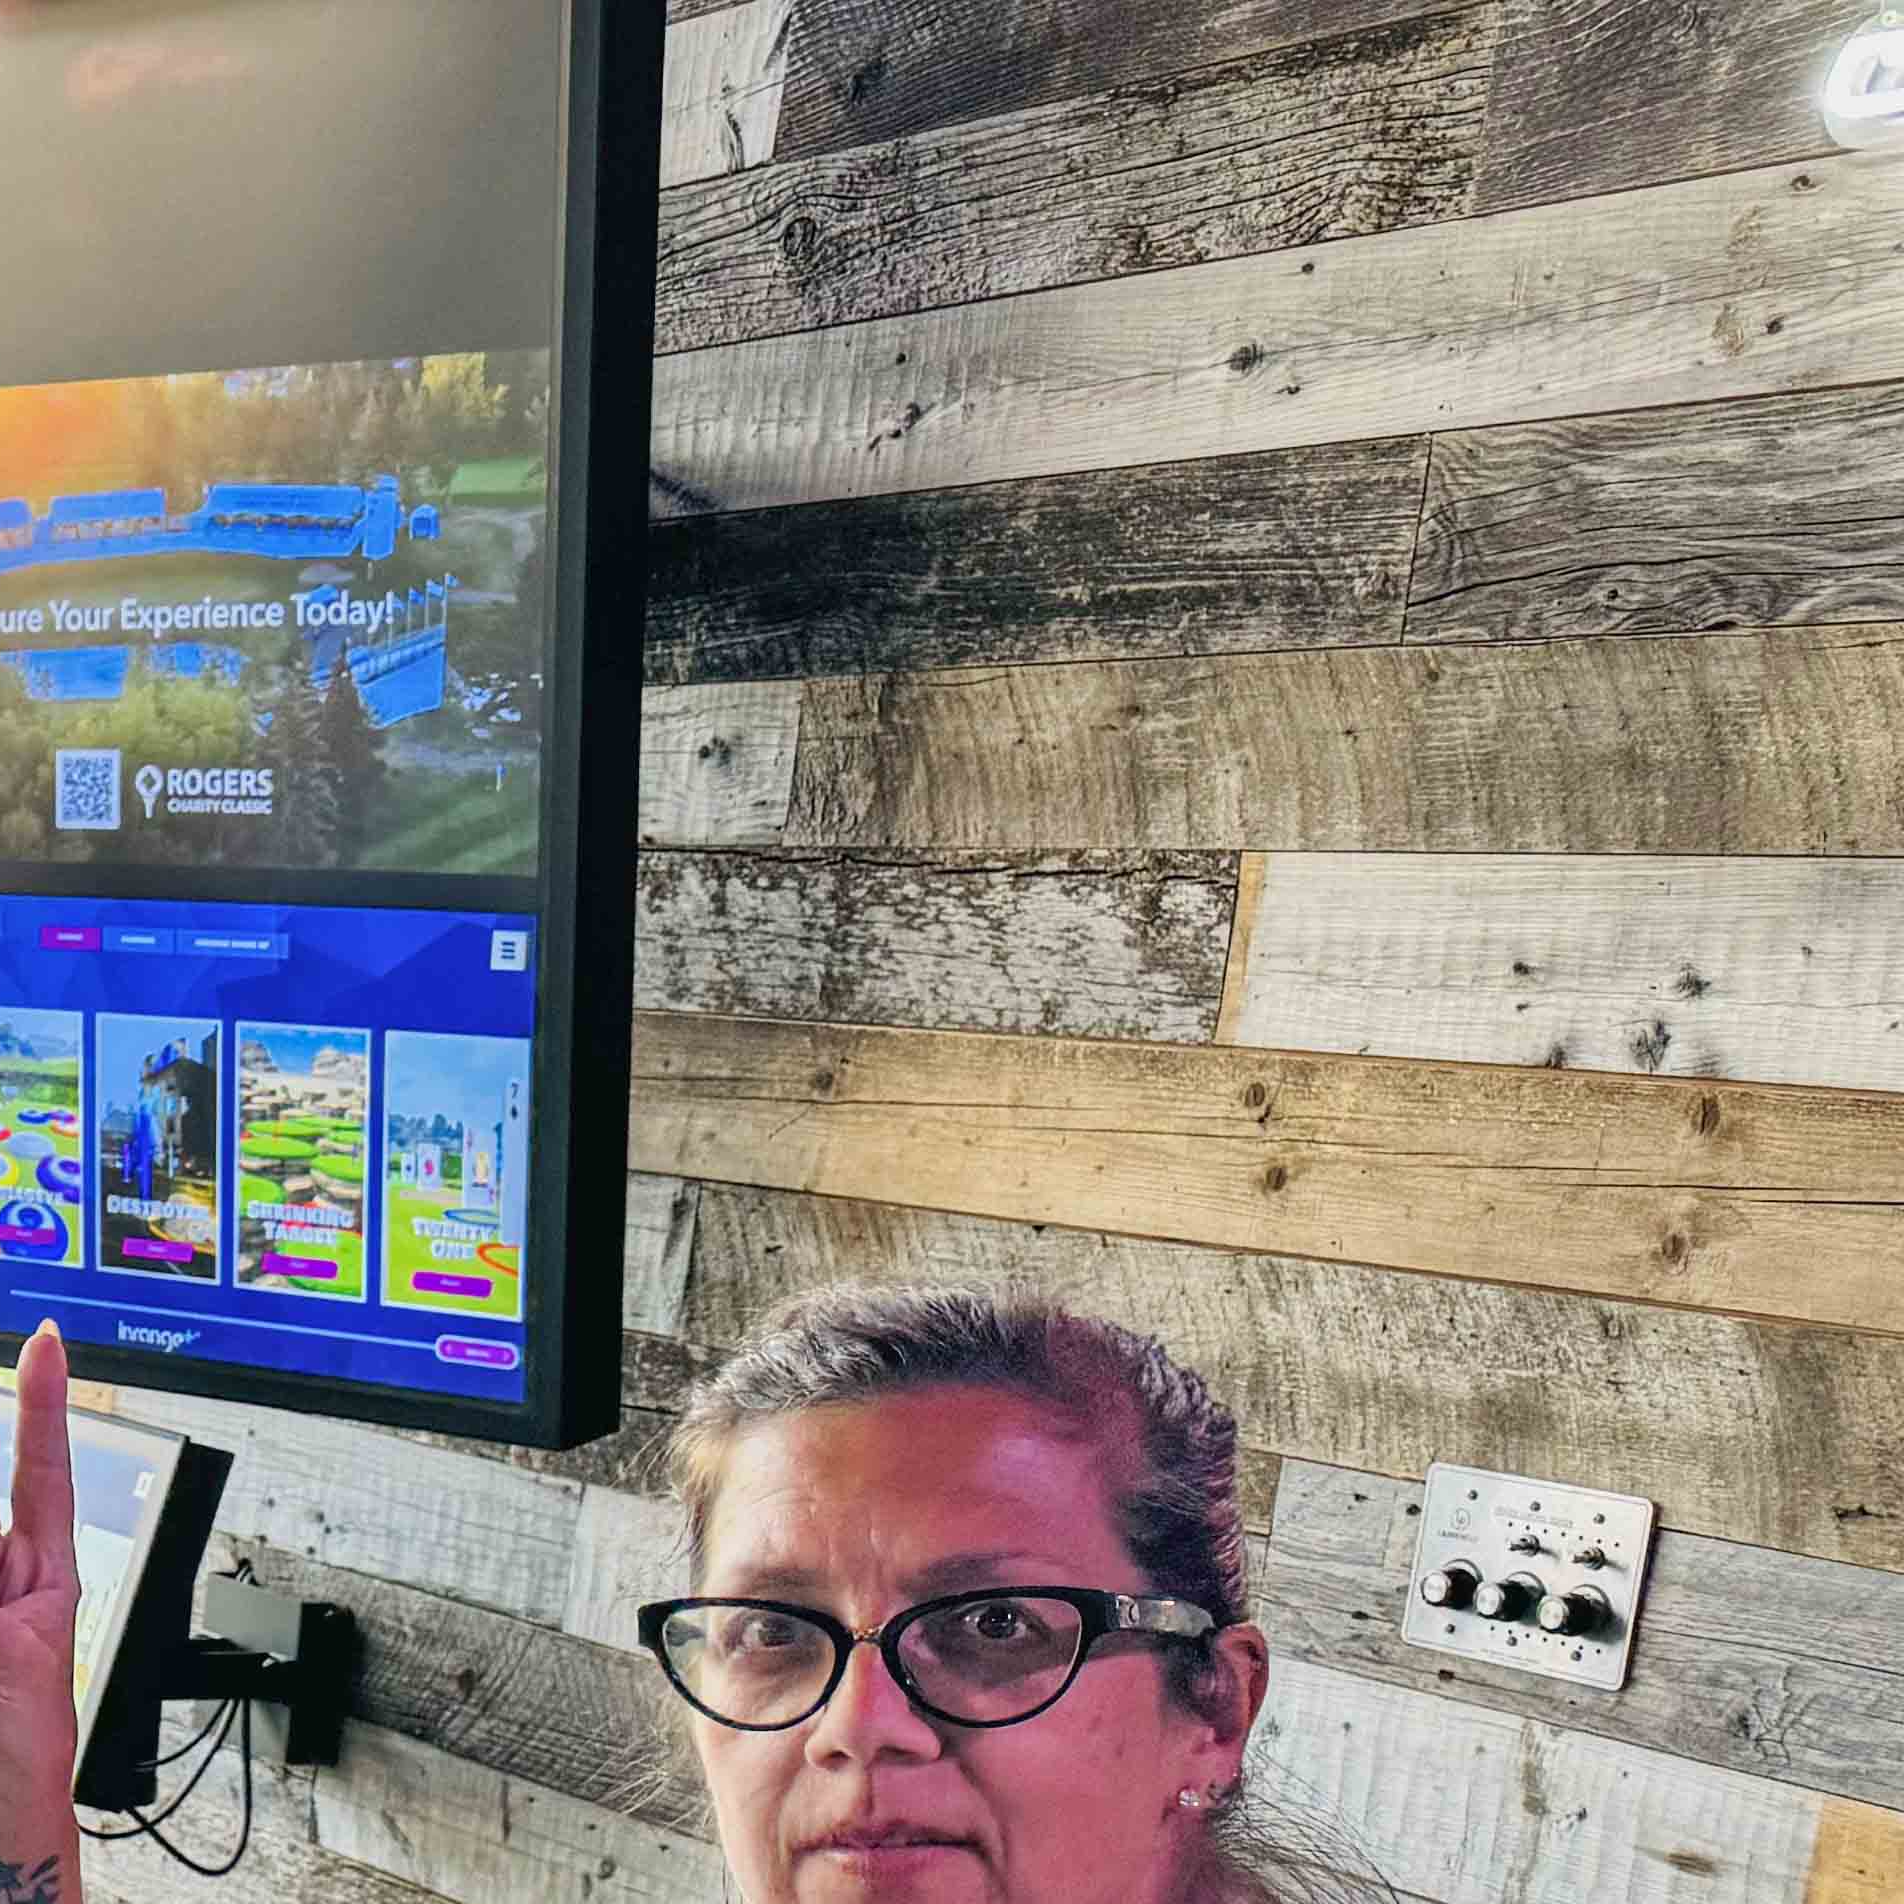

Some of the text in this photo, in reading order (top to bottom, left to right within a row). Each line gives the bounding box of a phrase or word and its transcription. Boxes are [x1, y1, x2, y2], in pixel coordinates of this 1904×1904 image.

[48, 599, 114, 632] Your
[120, 595, 284, 638] Experience
[290, 590, 393, 632] Today!
[167, 770, 273, 797] ROGERS
[221, 799, 273, 815] CLASSIC
[248, 1201, 354, 1228] SHRINKING
[262, 1220, 336, 1245] TARGET
[412, 1217, 495, 1241] TWENTY
